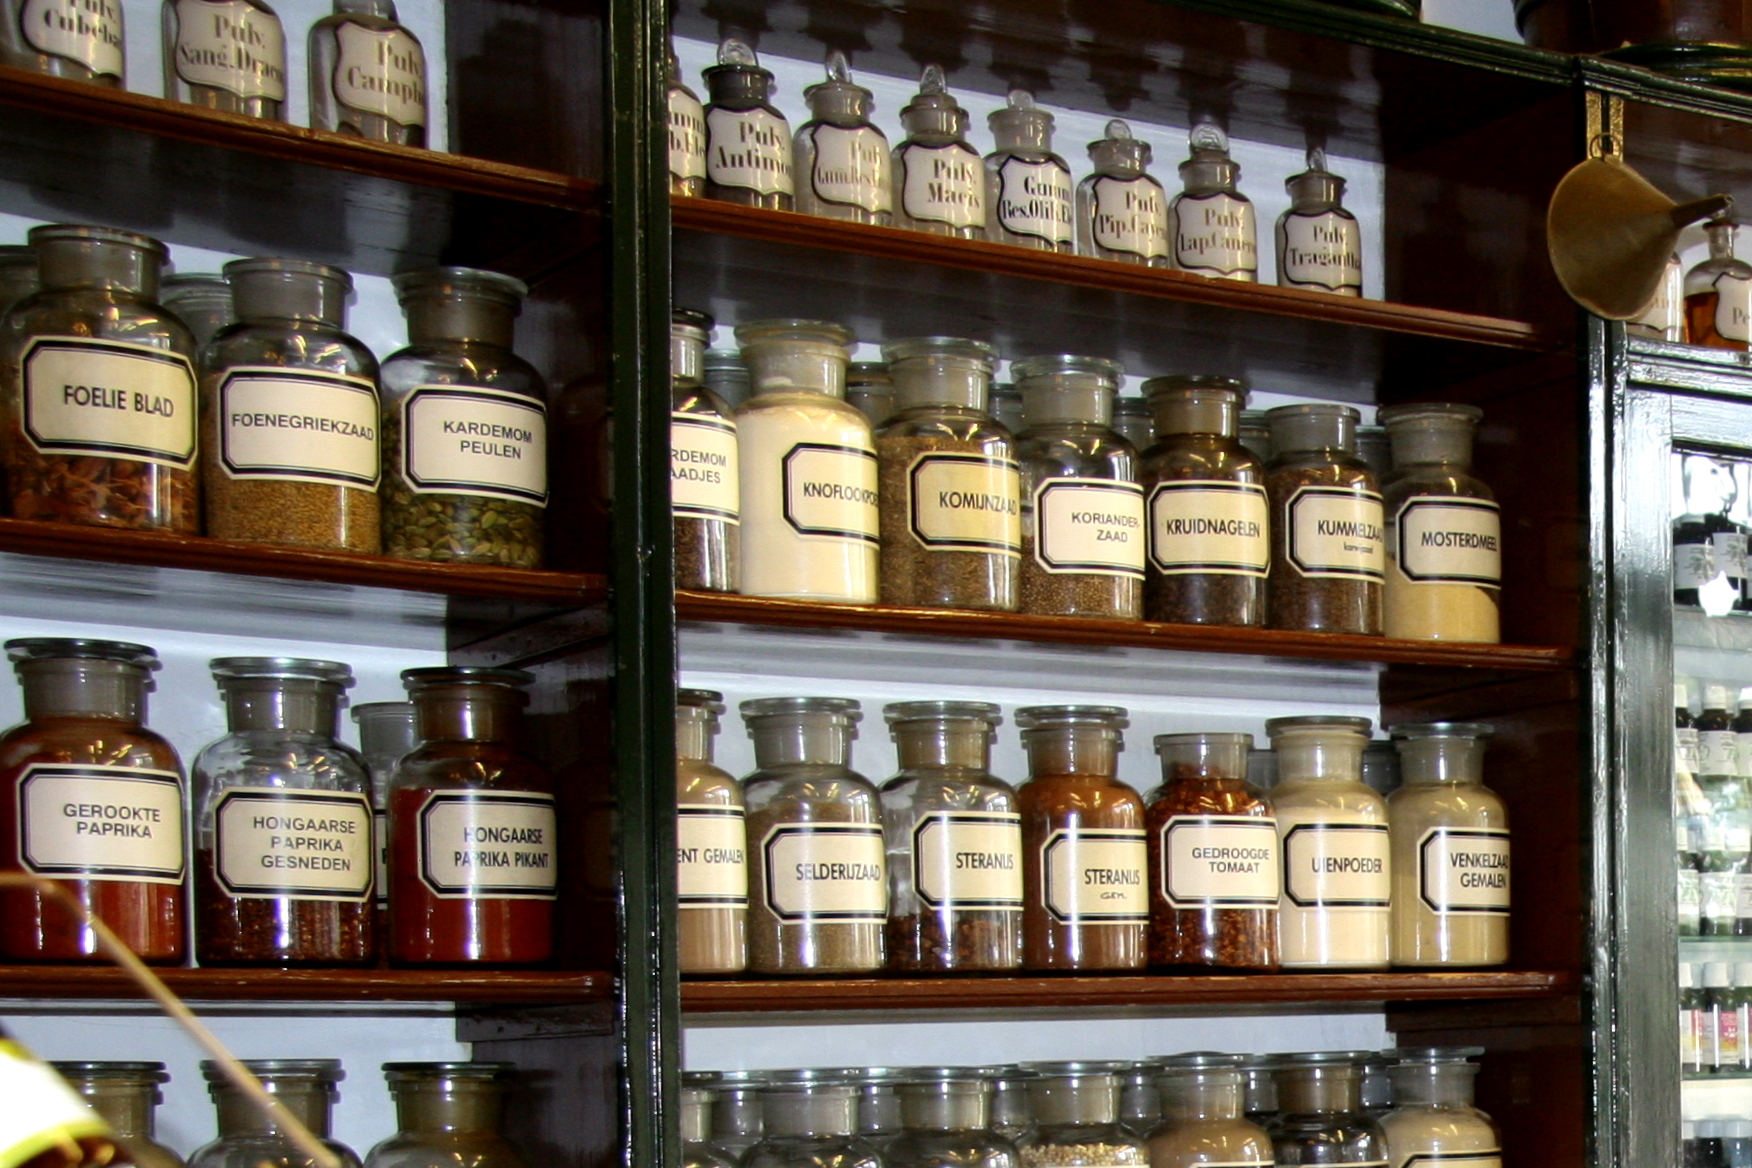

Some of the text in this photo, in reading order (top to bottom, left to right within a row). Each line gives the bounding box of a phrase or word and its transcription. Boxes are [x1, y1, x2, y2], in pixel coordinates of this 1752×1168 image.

[63, 384, 174, 419] FOELIE BLAD
[231, 412, 375, 441] FOENEGRIEKZAAD
[443, 420, 533, 444] KARDEMOM
[459, 439, 522, 460] PEULEN
[938, 490, 1018, 516] KOMIJNZAAD
[1096, 528, 1128, 544] ZAAD
[1166, 517, 1261, 539] KRUIDNAGELEN
[1421, 531, 1498, 553] MOSTERDMEEL
[63, 802, 161, 823] GEROOKTE
[76, 820, 153, 839] PAPRIKA
[253, 815, 357, 835] HONGAARSE
[270, 834, 344, 852] PAPRIKA
[463, 825, 543, 845] HONGAARSE
[261, 853, 351, 872] GESNEDEN
[453, 850, 509, 868] PAPRIKA
[515, 850, 549, 869] PIKANT
[955, 851, 1014, 870] STERANIJS
[1191, 846, 1270, 861] GEDROOGDE
[796, 861, 881, 882] SELDERIJZAAD
[1208, 861, 1260, 874] TOMAAT
[1311, 857, 1383, 874] UIENPOEDER
[1084, 867, 1141, 886] STERANIJS
[1460, 872, 1507, 889] GEMALEN
